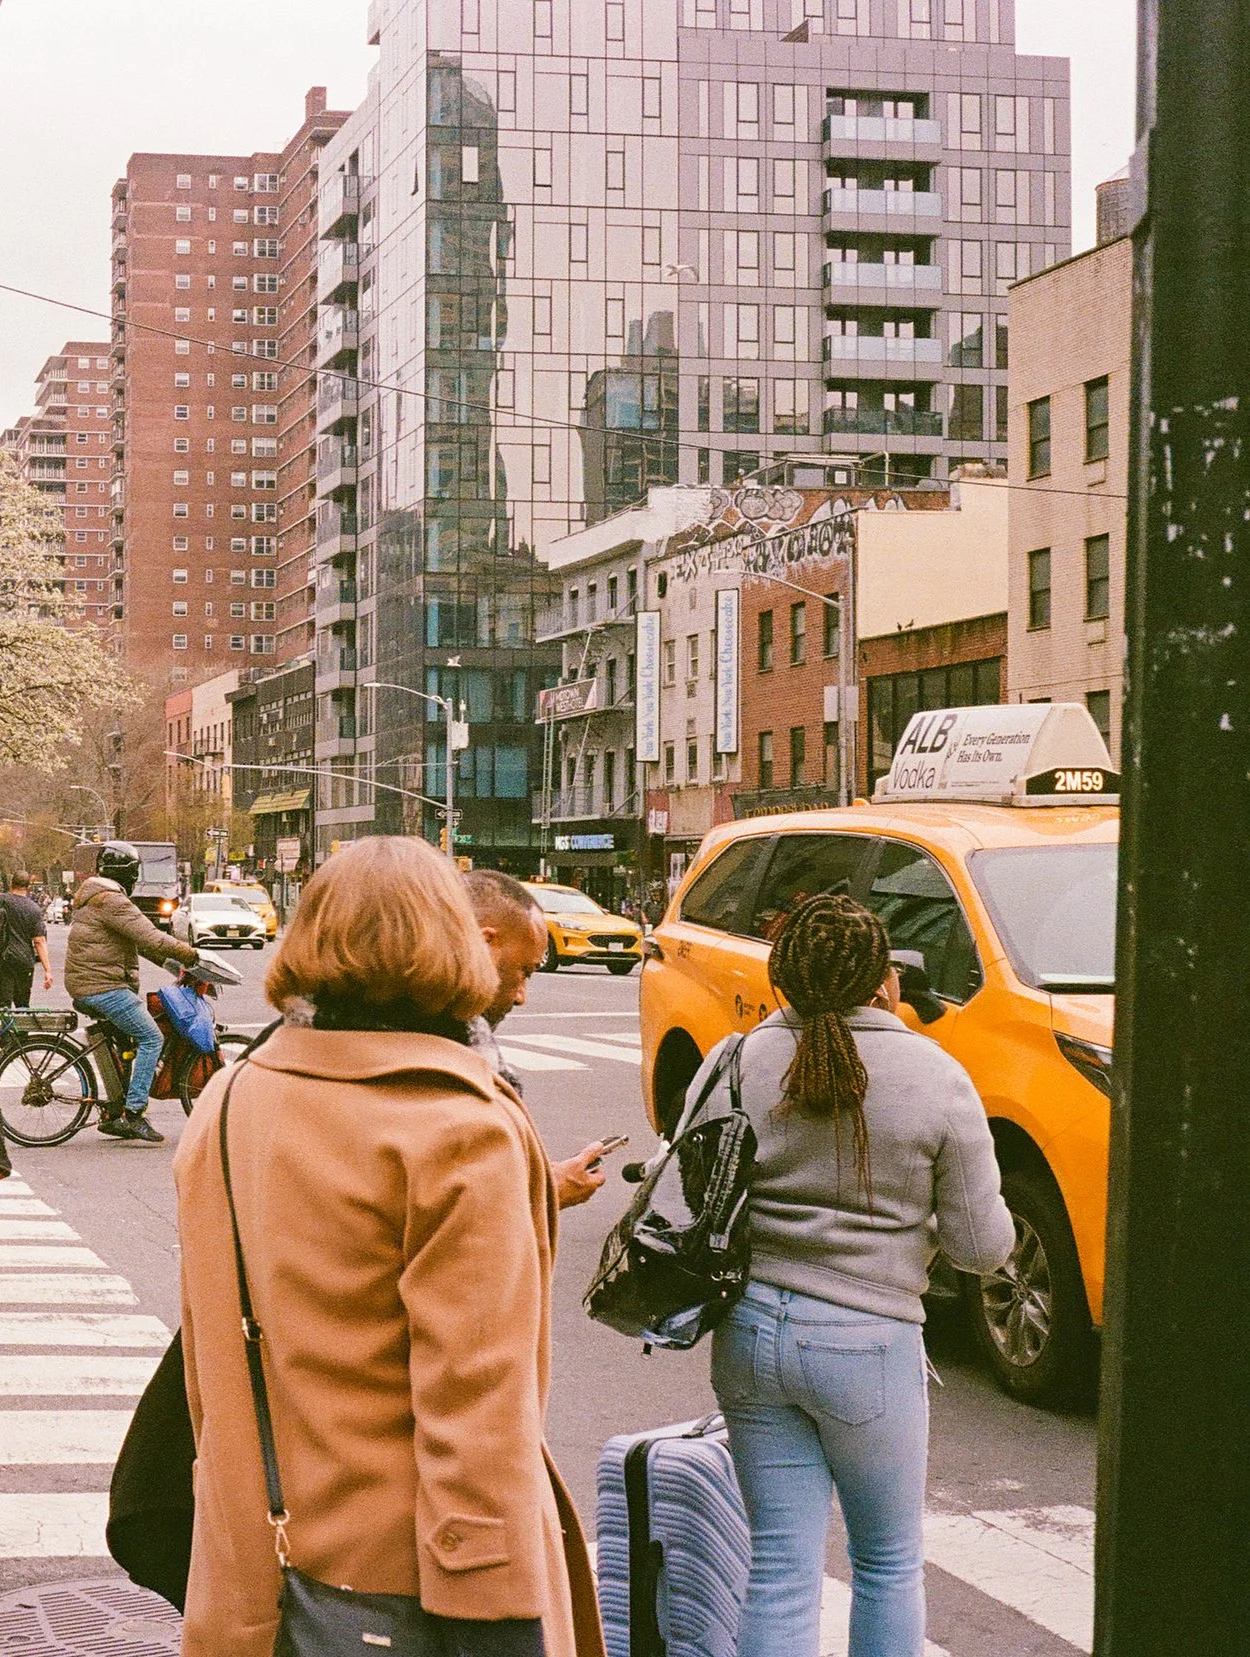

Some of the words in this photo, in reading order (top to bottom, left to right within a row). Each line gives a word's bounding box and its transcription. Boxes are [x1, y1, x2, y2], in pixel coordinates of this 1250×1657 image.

[900, 714, 958, 755] ALB
[962, 733, 988, 748] Every
[986, 731, 1031, 746] Generation
[956, 750, 970, 763] Has
[970, 749, 982, 762] Its
[893, 760, 936, 790] Vodka
[1054, 771, 1104, 791] 2M59
